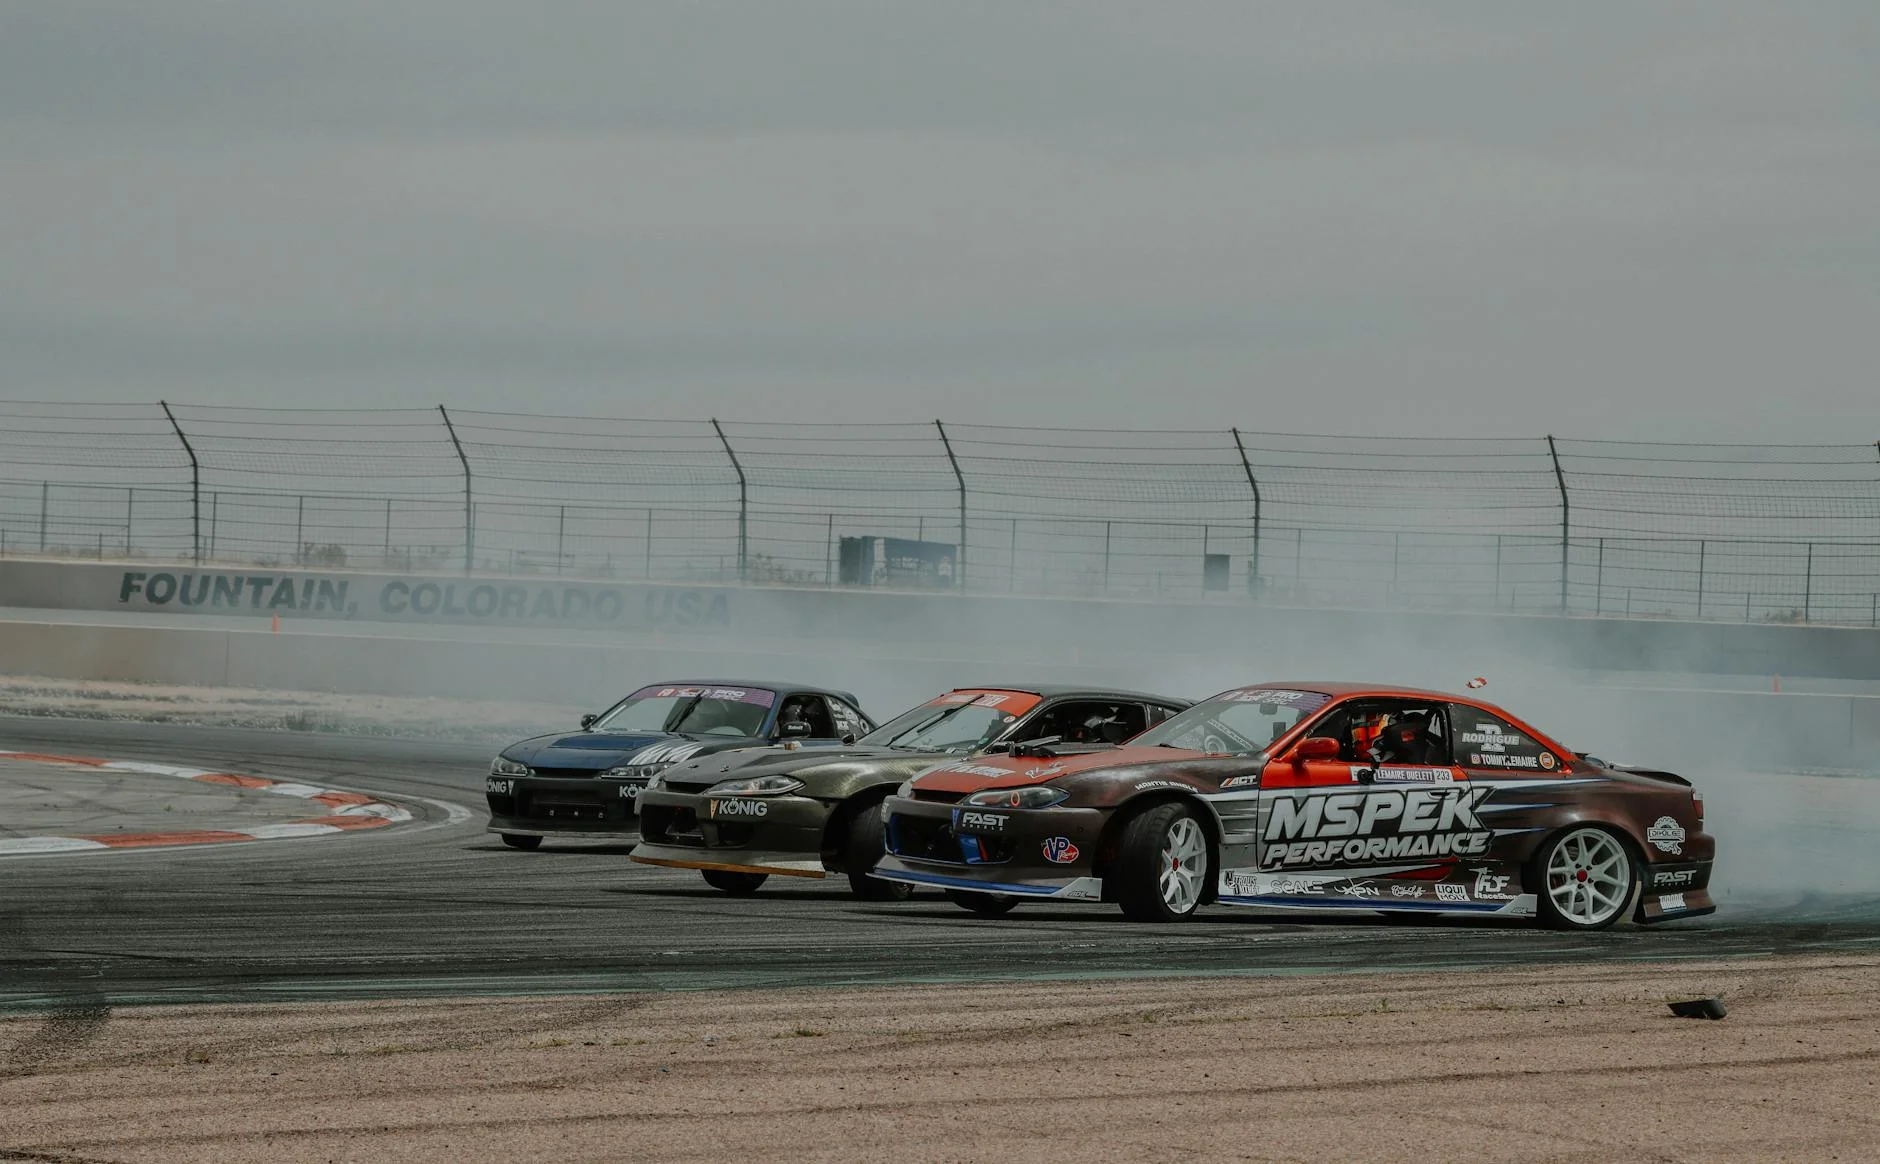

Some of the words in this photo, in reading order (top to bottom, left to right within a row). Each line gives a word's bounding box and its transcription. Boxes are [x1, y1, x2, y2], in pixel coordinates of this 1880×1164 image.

[119, 572, 358, 618] FOUNTAIN,
[379, 580, 625, 621] COLORADO
[643, 589, 731, 627] USA
[1461, 732, 1520, 746] RODRIGUE
[1377, 769, 1405, 780] LEMAIRE
[1436, 770, 1450, 781] 233
[719, 798, 768, 817] KÖNIG
[1264, 788, 1490, 841] MSPEK
[962, 811, 1010, 827] FAST
[1045, 836, 1071, 862] VP
[1262, 832, 1491, 866] PERFORMANCE
[1653, 869, 1697, 883] FAST
[1271, 879, 1325, 895] SCALE
[1437, 885, 1463, 894] LIQUI
